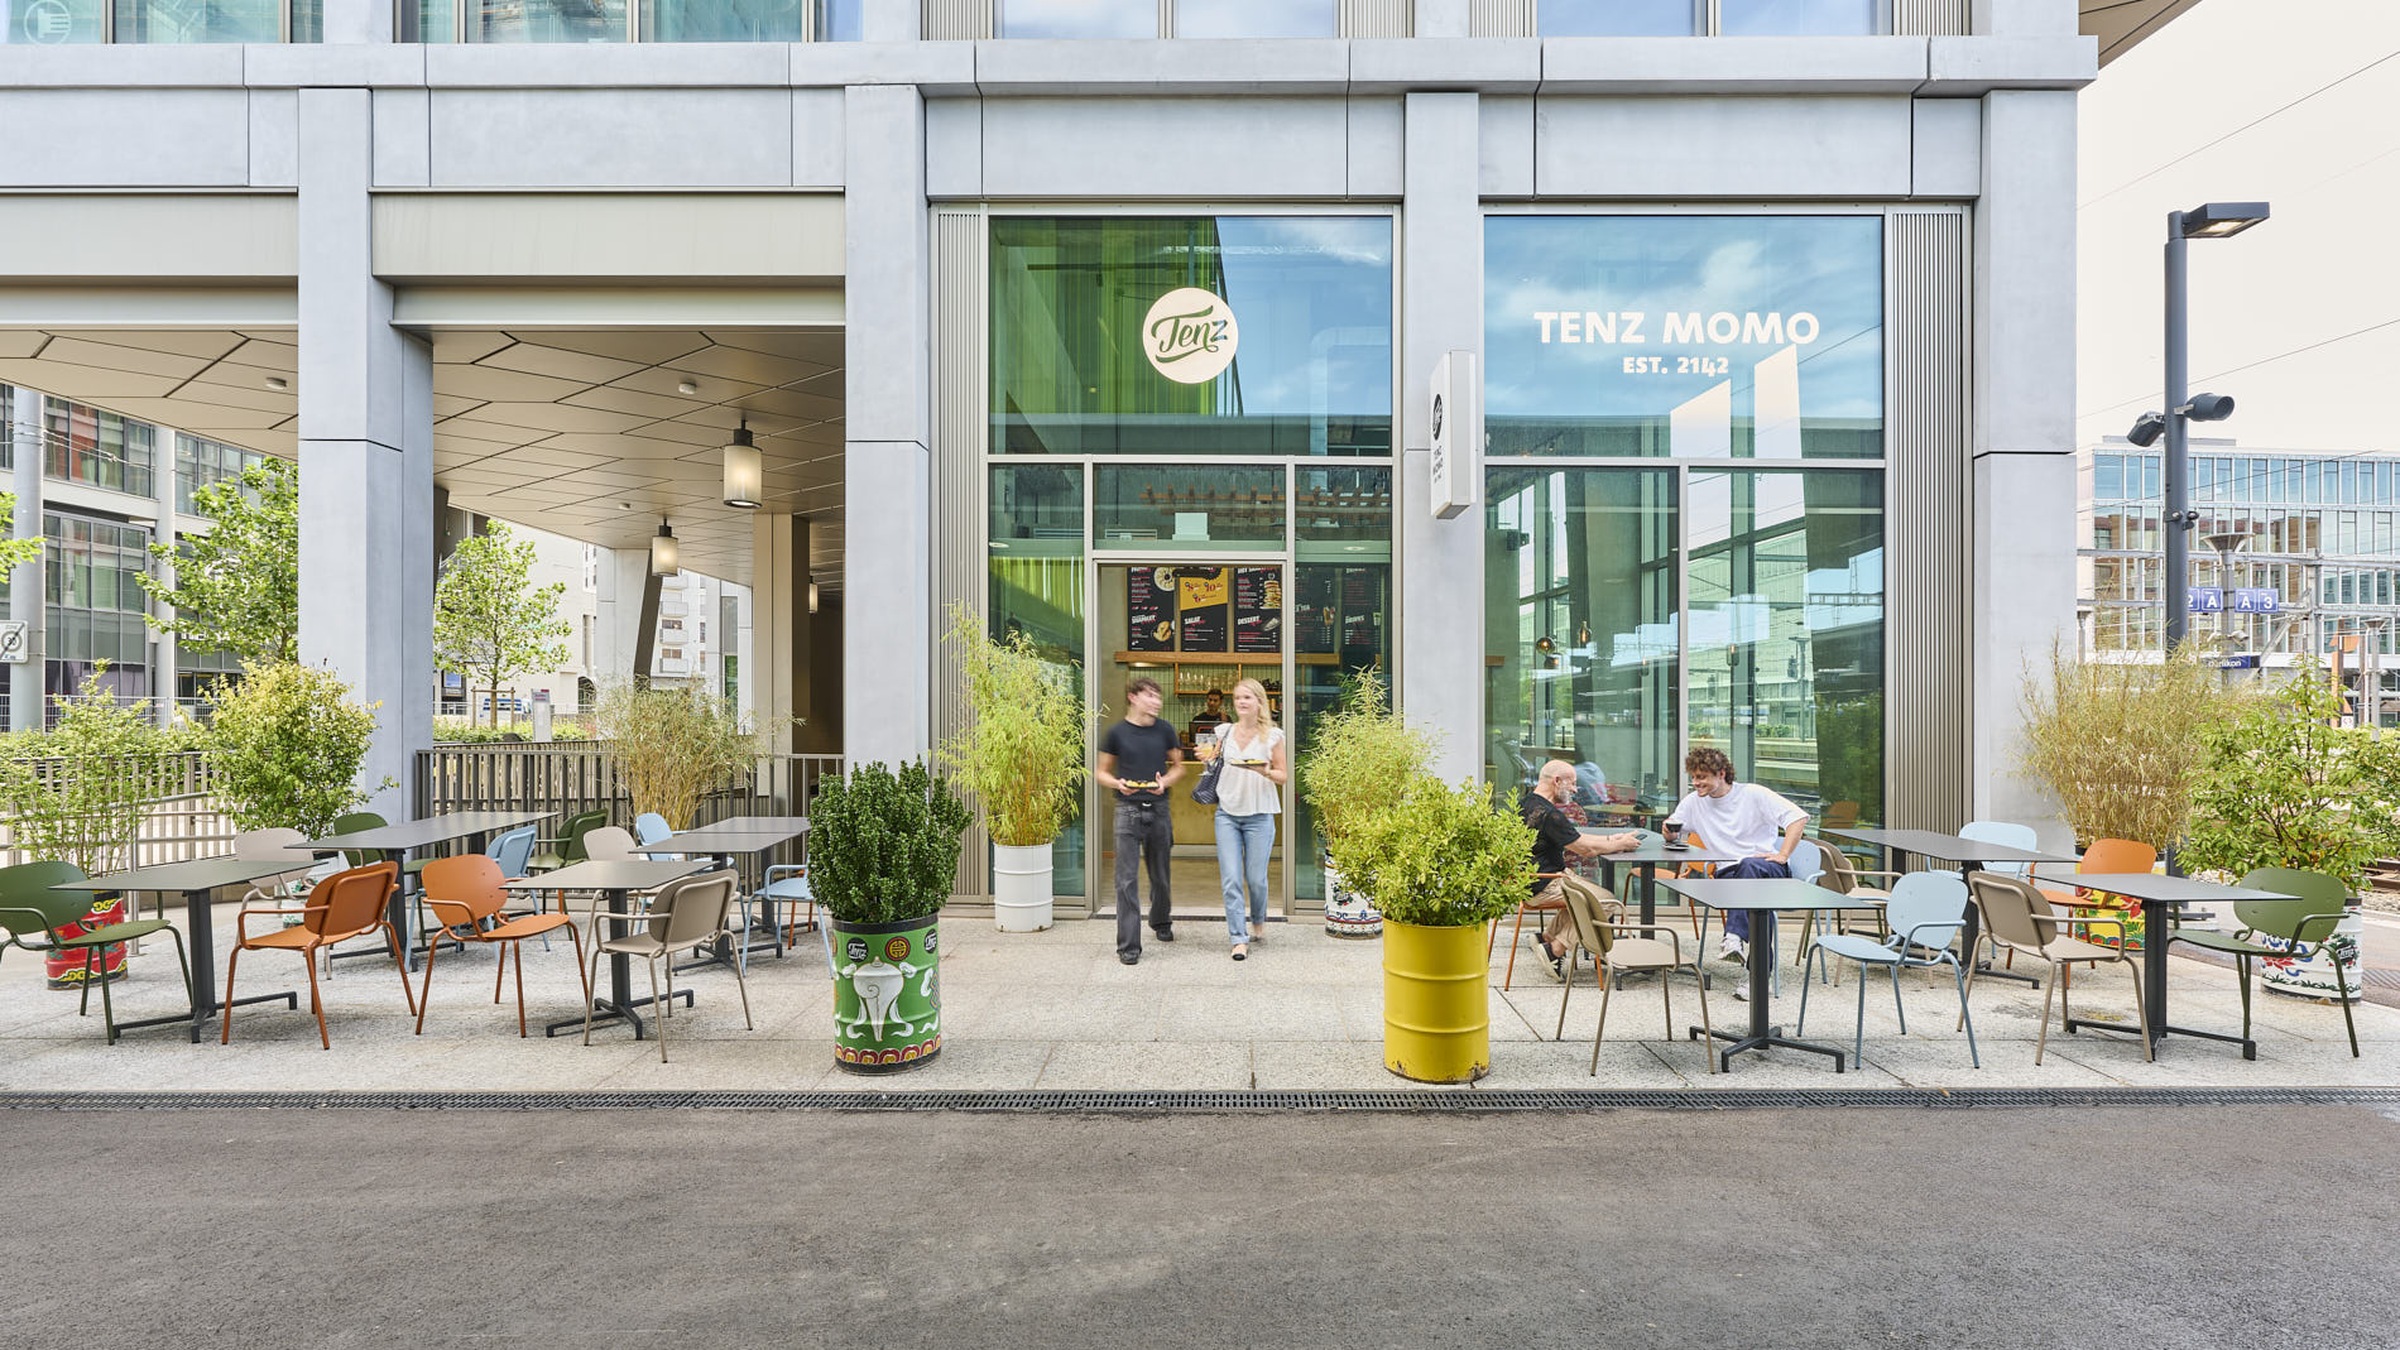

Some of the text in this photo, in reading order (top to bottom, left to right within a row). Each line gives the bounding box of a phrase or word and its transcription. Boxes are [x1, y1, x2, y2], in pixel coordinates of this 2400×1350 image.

[1151, 305, 1228, 364] Tenz
[1534, 312, 1820, 344] TENZ MOMO
[1623, 357, 1729, 378] EST. 2142
[2207, 596, 2217, 608] A
[2241, 596, 2273, 609] A 3
